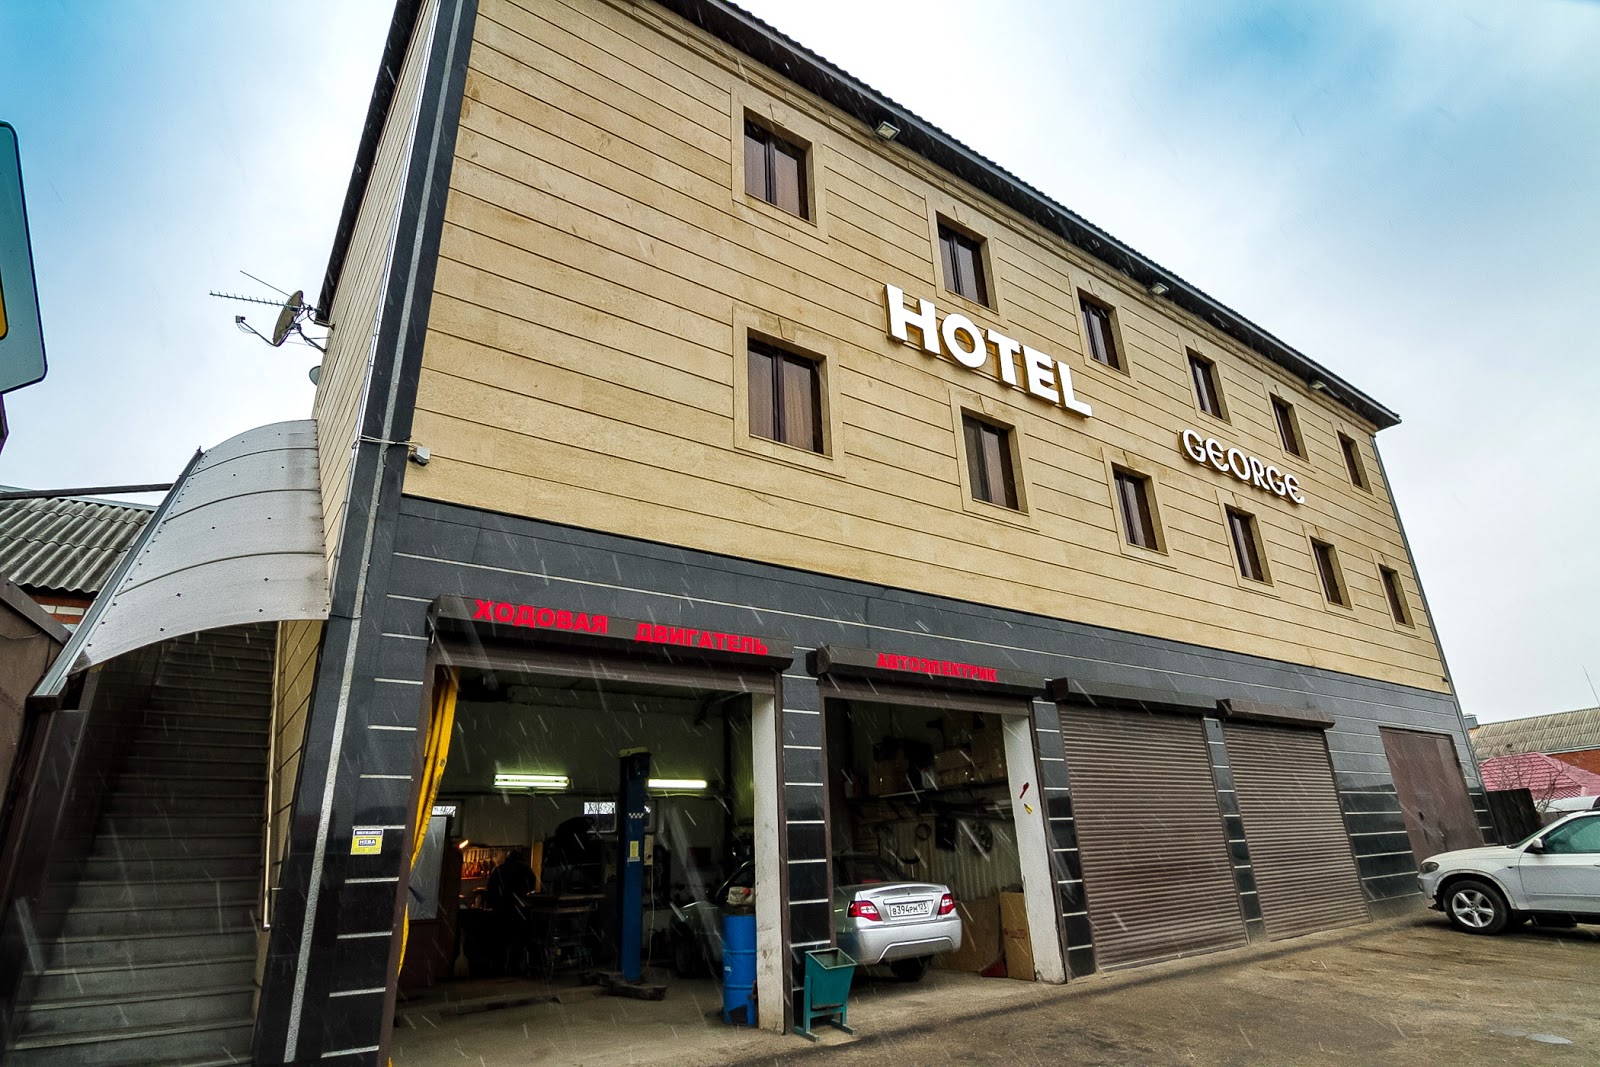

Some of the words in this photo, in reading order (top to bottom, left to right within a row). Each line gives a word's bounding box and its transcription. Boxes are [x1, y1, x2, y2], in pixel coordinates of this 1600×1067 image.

[885, 283, 1093, 417] HOTEL
[1181, 428, 1306, 504] GEORGE
[472, 599, 608, 635] ХОДОВАЯ
[634, 622, 768, 656] ДВИГАТЕЛЬ
[876, 653, 998, 683] АВТОЭЛЕКТРИК
